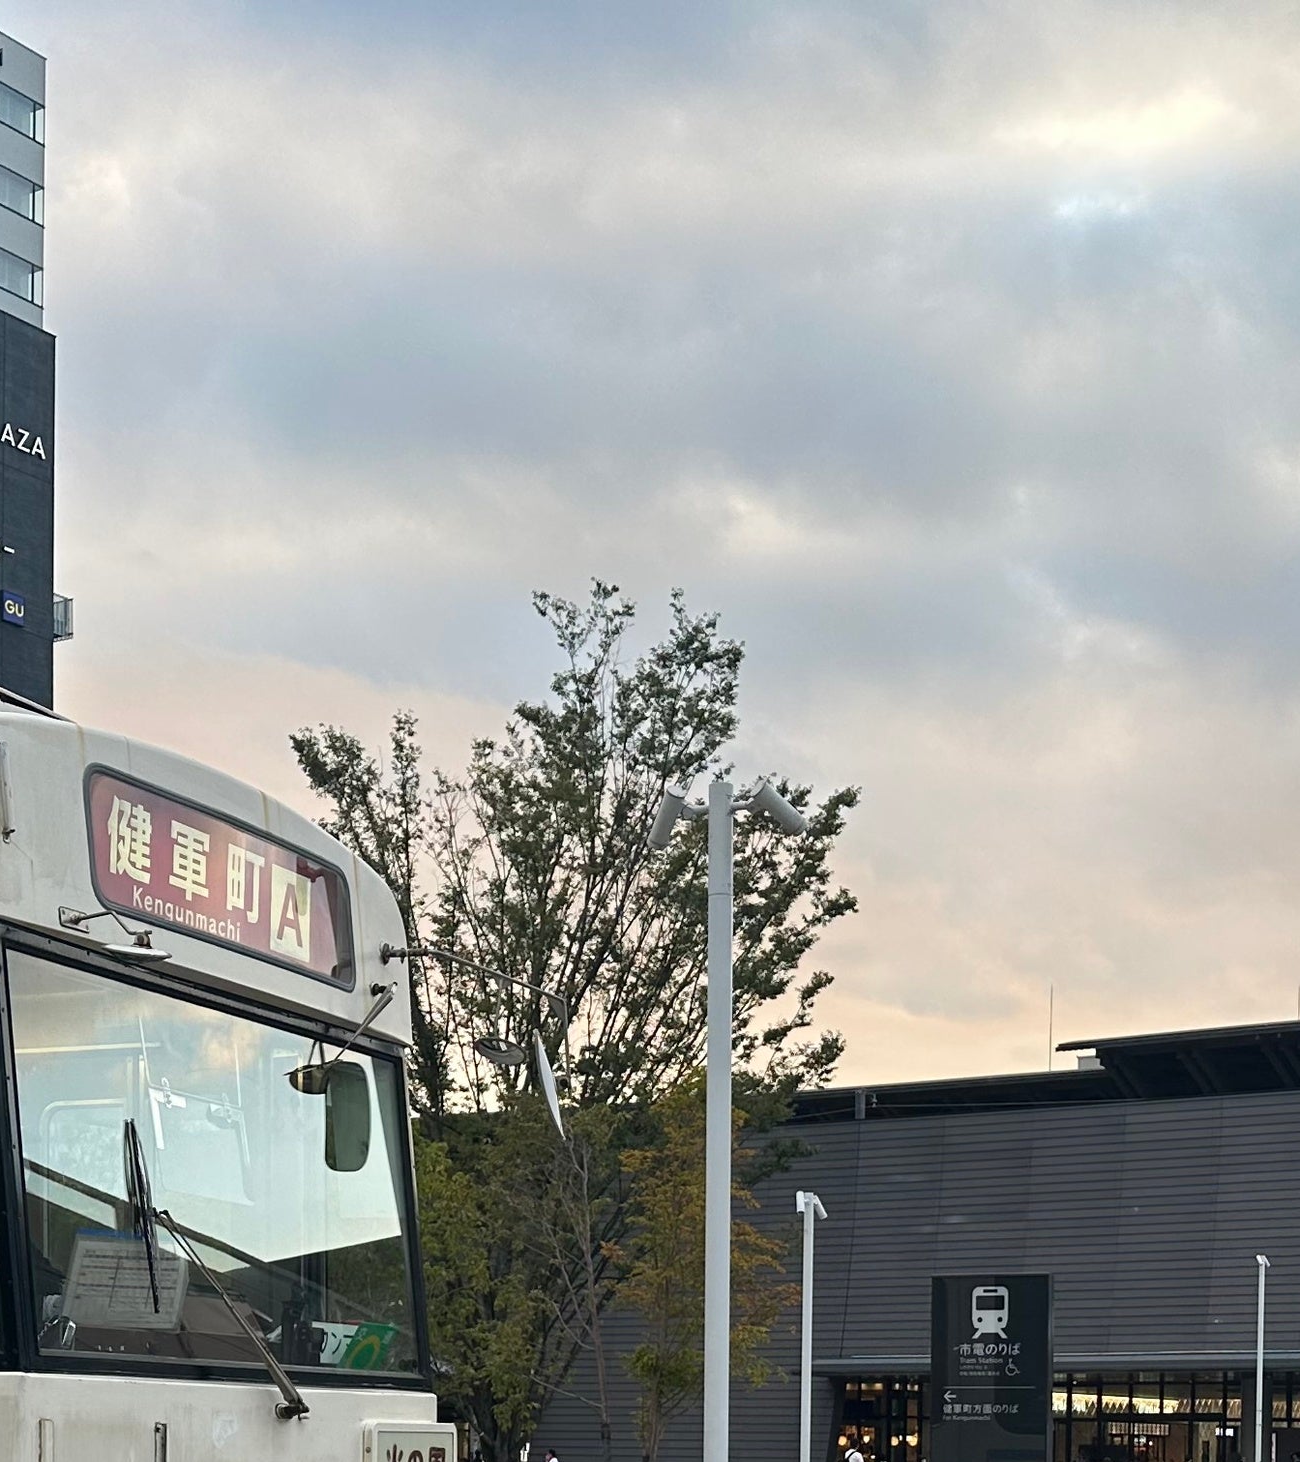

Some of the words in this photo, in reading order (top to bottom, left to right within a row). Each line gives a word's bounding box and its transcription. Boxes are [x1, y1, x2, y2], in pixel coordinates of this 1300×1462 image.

[4, 599, 25, 618] GU
[106, 795, 266, 925] 健軍町
[276, 883, 303, 949] A
[132, 884, 241, 943] Kengunmachi
[959, 1343, 1021, 1356] 市電のりば
